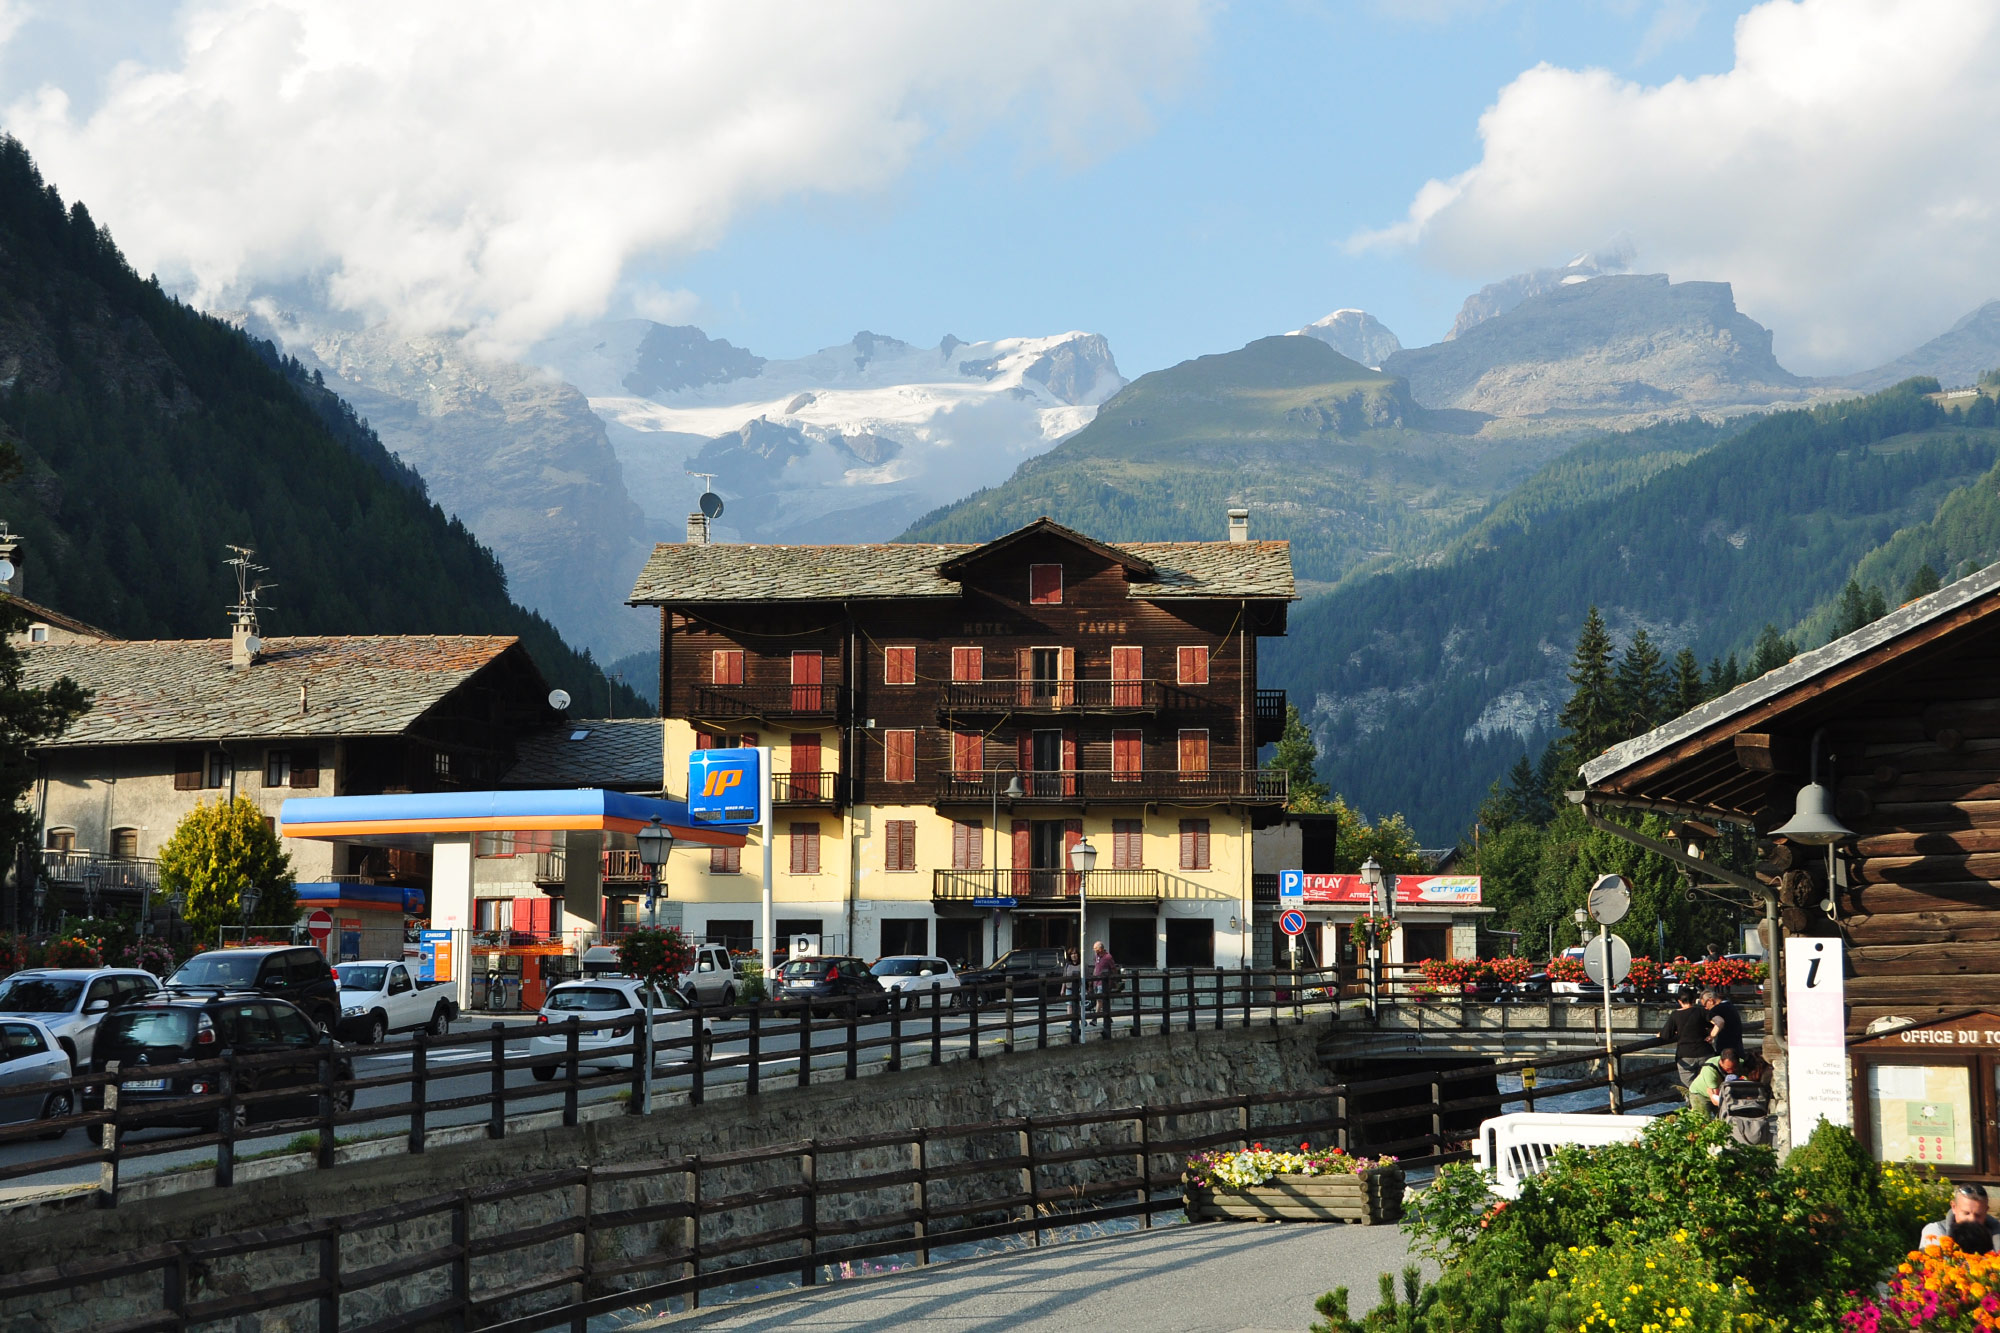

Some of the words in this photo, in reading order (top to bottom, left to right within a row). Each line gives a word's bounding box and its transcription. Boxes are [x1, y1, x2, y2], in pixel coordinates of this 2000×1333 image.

[963, 623, 1013, 634] HOTEL
[1078, 622, 1127, 634] FAVRE
[702, 769, 743, 797] IP
[1285, 873, 1299, 894] P
[1314, 876, 1342, 889] PLAY
[797, 937, 810, 953] D
[1806, 942, 1824, 989] i
[1900, 1030, 1953, 1044] OFFICE
[1958, 1030, 1979, 1044] DU
